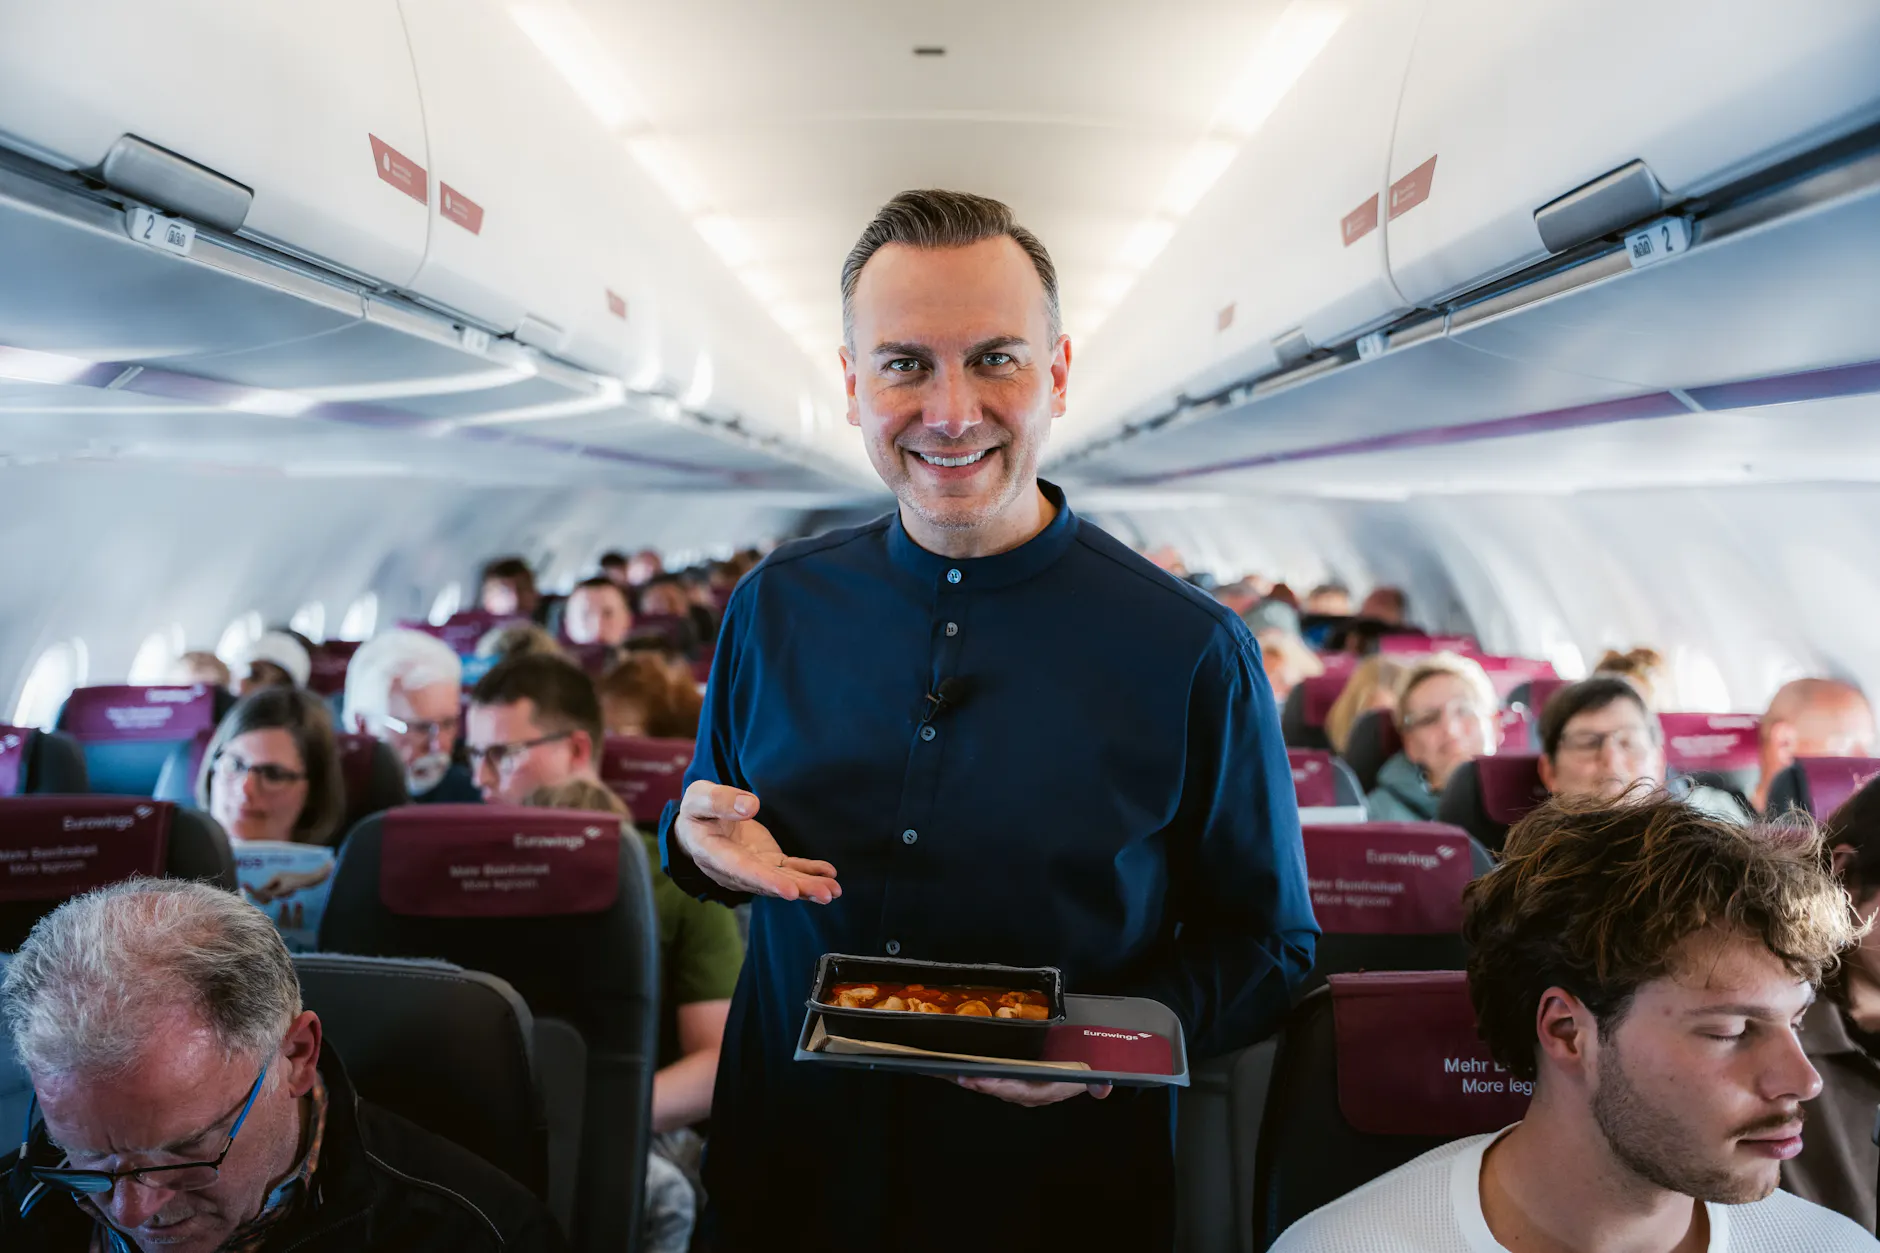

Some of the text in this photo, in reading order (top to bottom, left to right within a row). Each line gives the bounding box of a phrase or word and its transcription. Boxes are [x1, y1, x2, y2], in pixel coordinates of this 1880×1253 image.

[144, 214, 155, 239] 2
[1662, 225, 1674, 252] 2
[1366, 849, 1439, 870] Eurowings
[1083, 1029, 1139, 1041] Eurowings
[1444, 1057, 1489, 1073] Mehr
[1462, 1078, 1504, 1094] More
